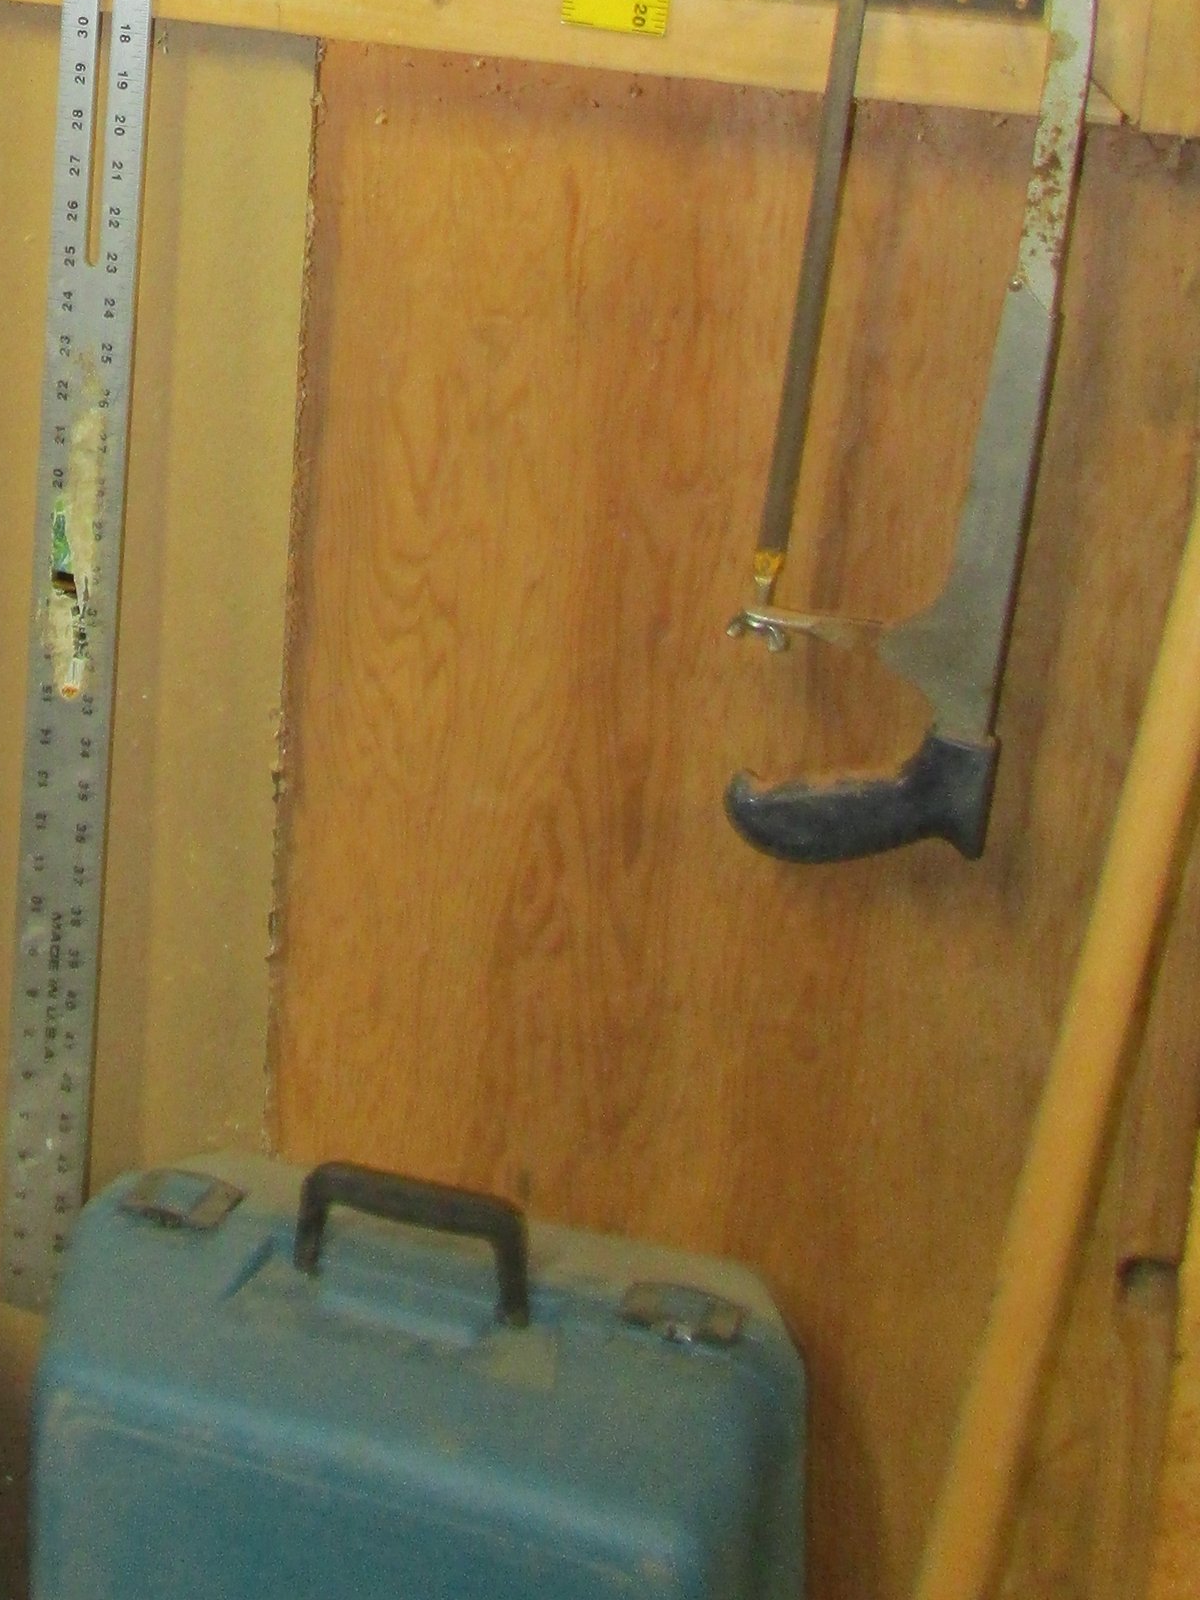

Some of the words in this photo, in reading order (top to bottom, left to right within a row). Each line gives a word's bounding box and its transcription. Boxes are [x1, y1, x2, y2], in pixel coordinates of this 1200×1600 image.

[78, 17, 89, 38] 30
[120, 25, 131, 43] 18
[75, 63, 86, 85] 29
[117, 72, 128, 90] 19
